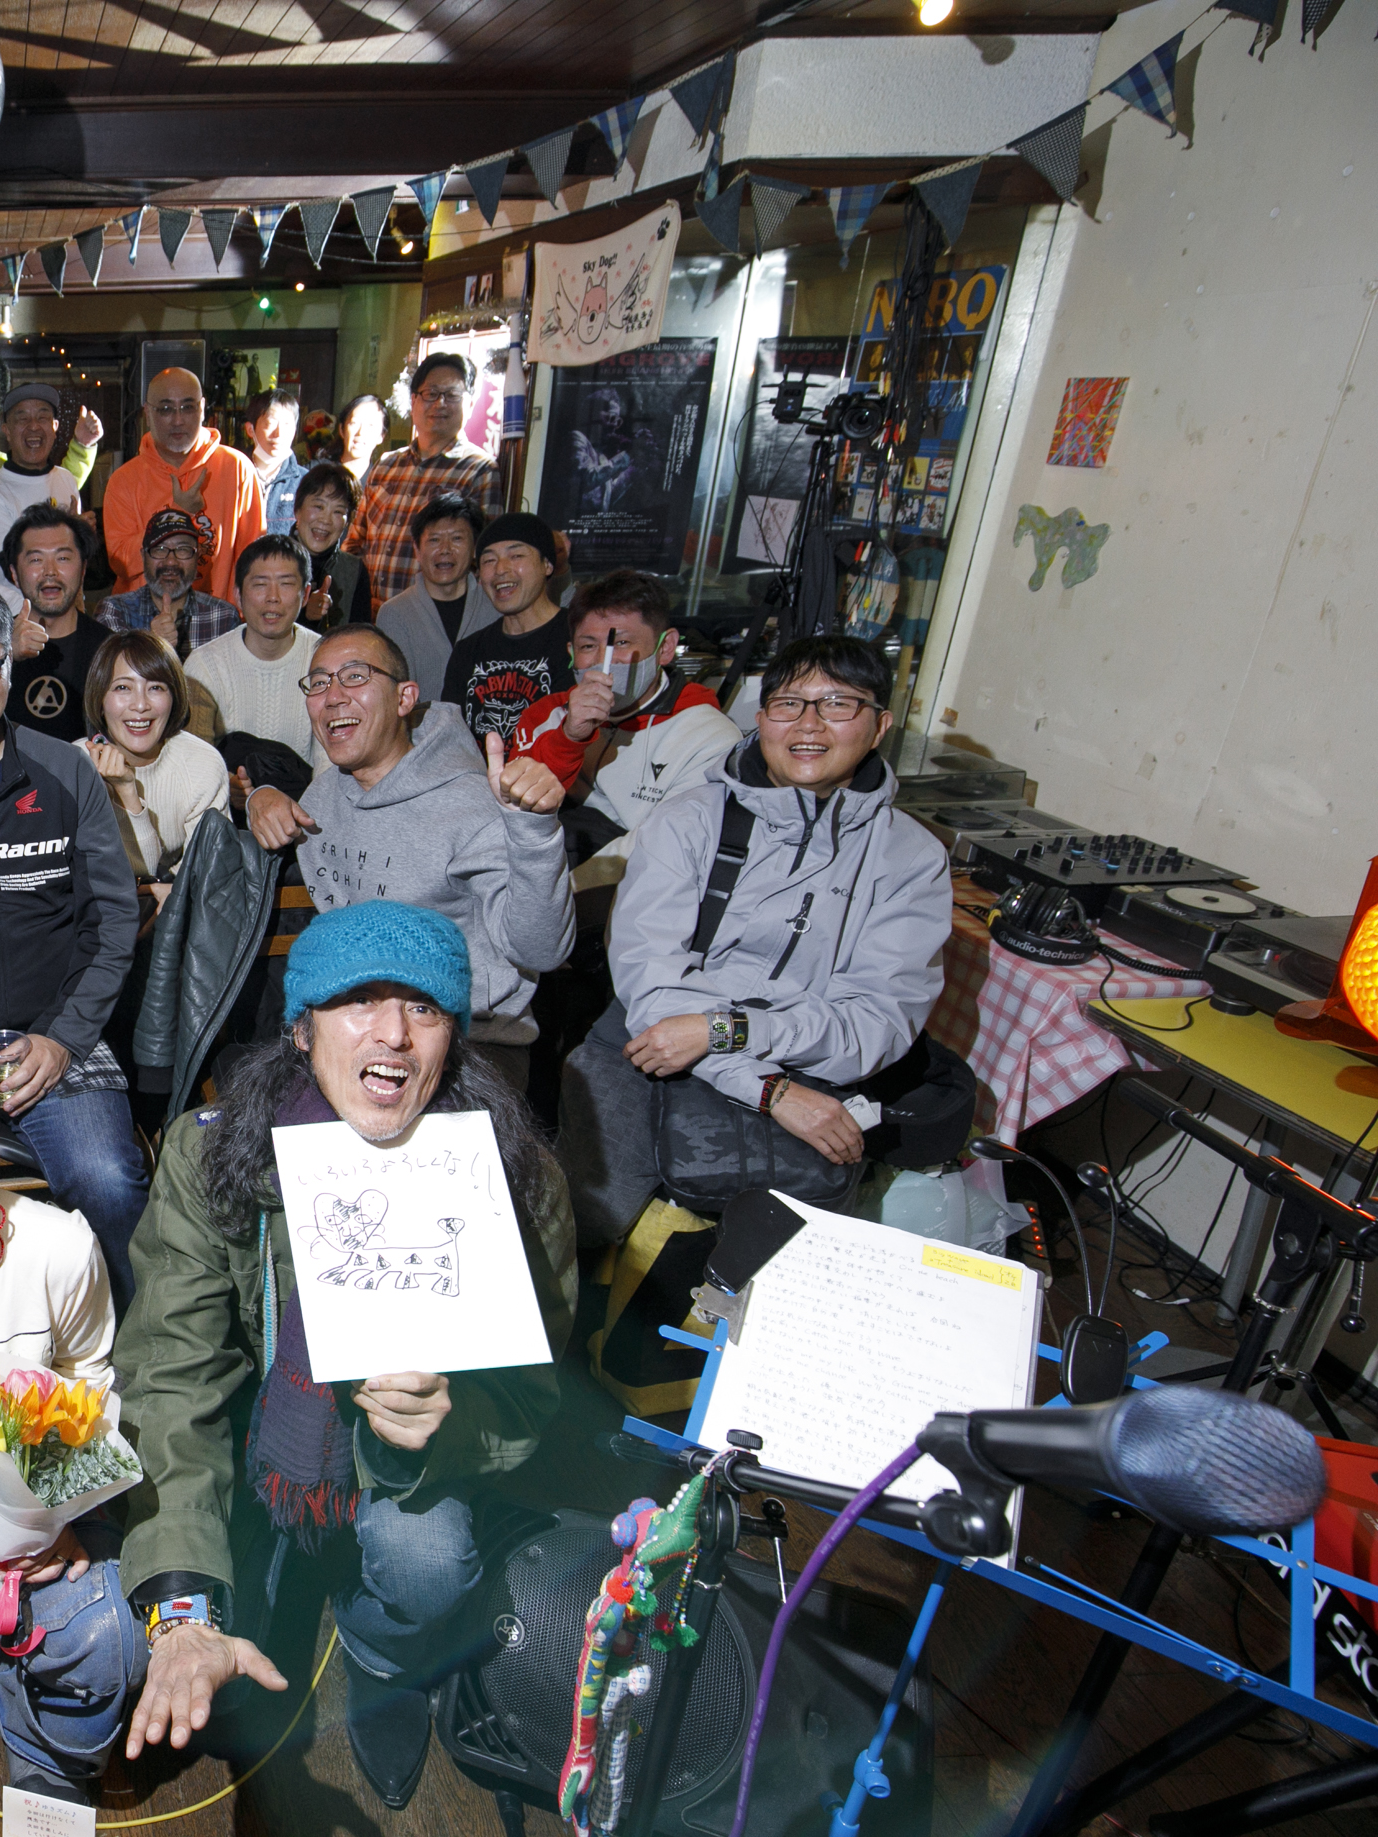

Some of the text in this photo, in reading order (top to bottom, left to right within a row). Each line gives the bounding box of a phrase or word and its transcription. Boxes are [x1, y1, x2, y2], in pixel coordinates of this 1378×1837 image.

[583, 253, 618, 273] Sky Dog!!
[866, 272, 997, 332] NBQ
[16, 807, 43, 815] HONDA
[1007, 936, 1085, 960] audio-technica
